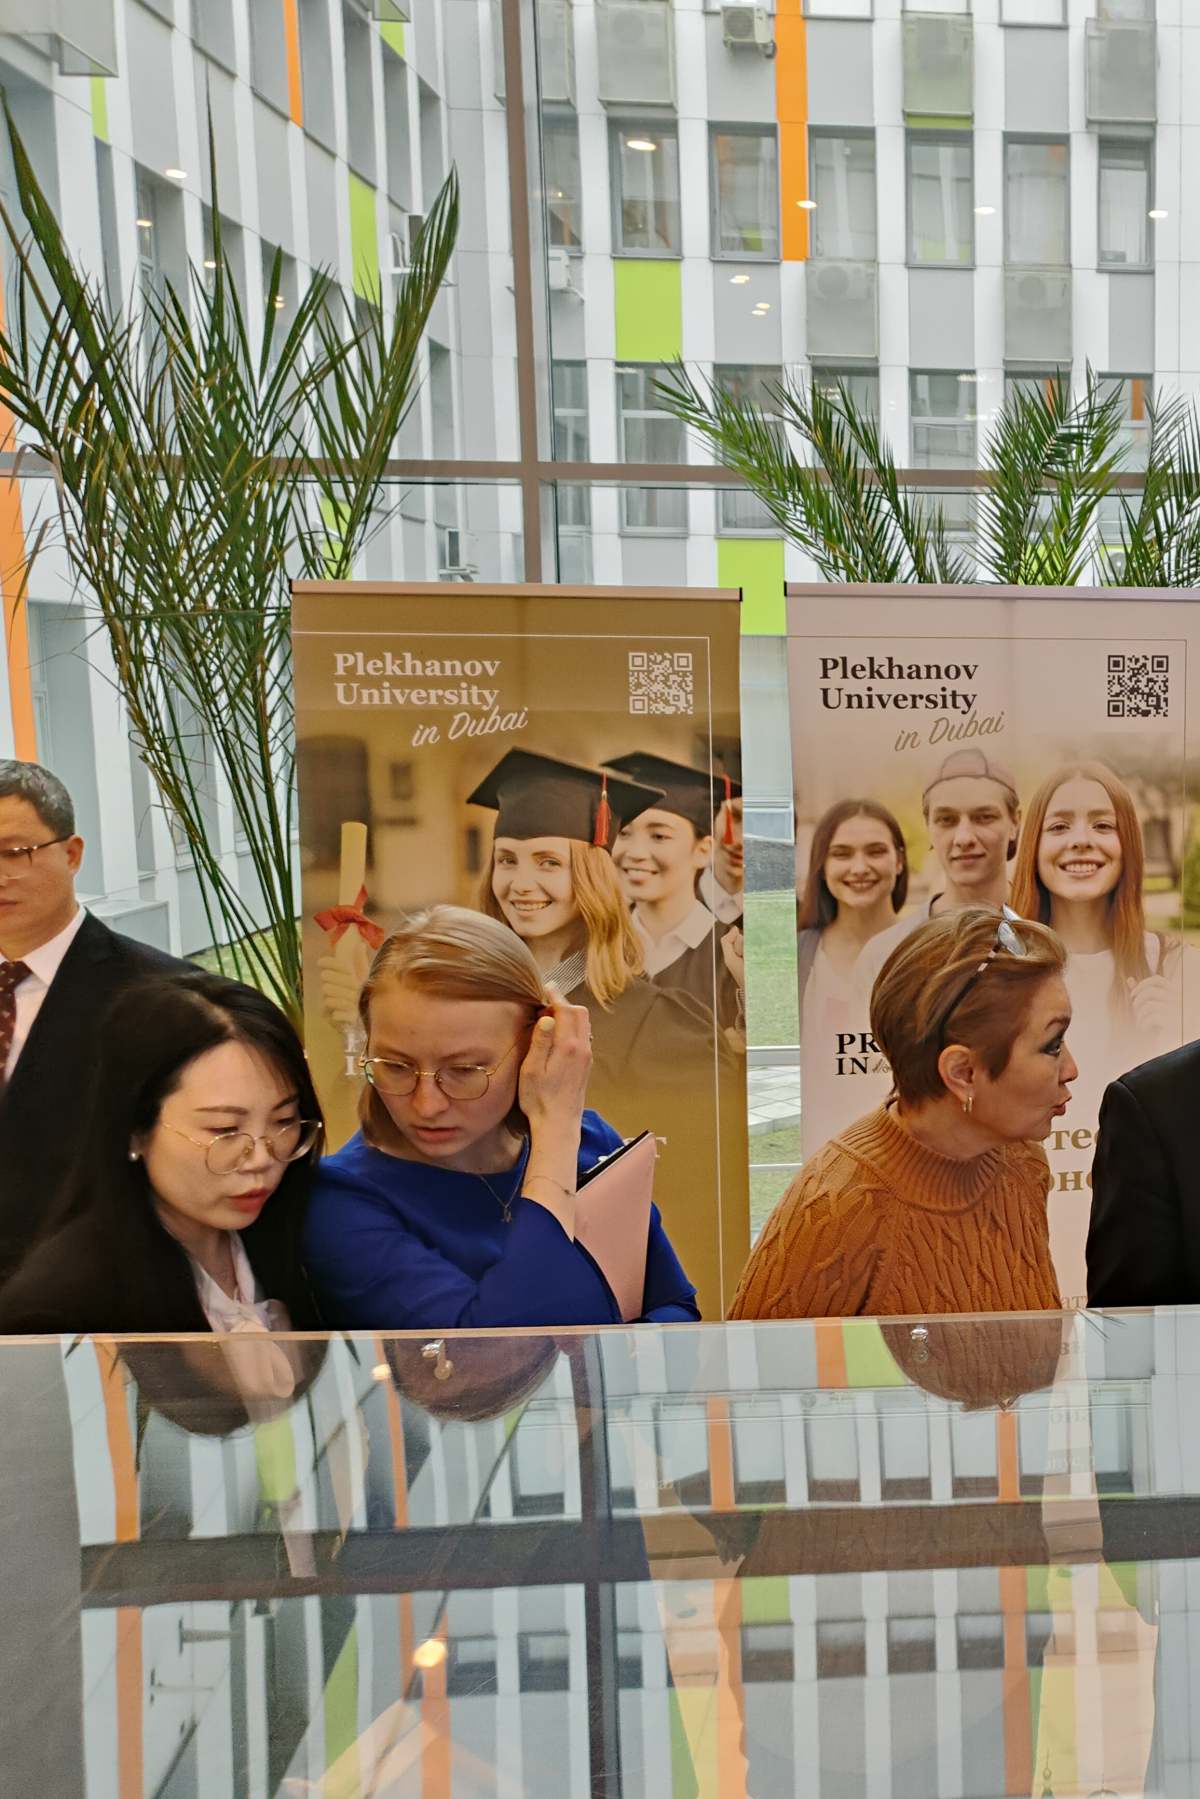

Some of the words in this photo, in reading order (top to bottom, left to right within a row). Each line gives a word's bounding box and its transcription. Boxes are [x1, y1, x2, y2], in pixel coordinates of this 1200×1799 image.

[334, 652, 501, 678] Plekhanov
[819, 656, 979, 680] Plekhanov
[335, 682, 500, 711] University
[820, 687, 978, 714] University
[412, 724, 440, 747] in
[448, 707, 529, 741] Dubai
[894, 729, 921, 752] in
[928, 711, 1006, 746] Dubai
[835, 1057, 869, 1075] IN
